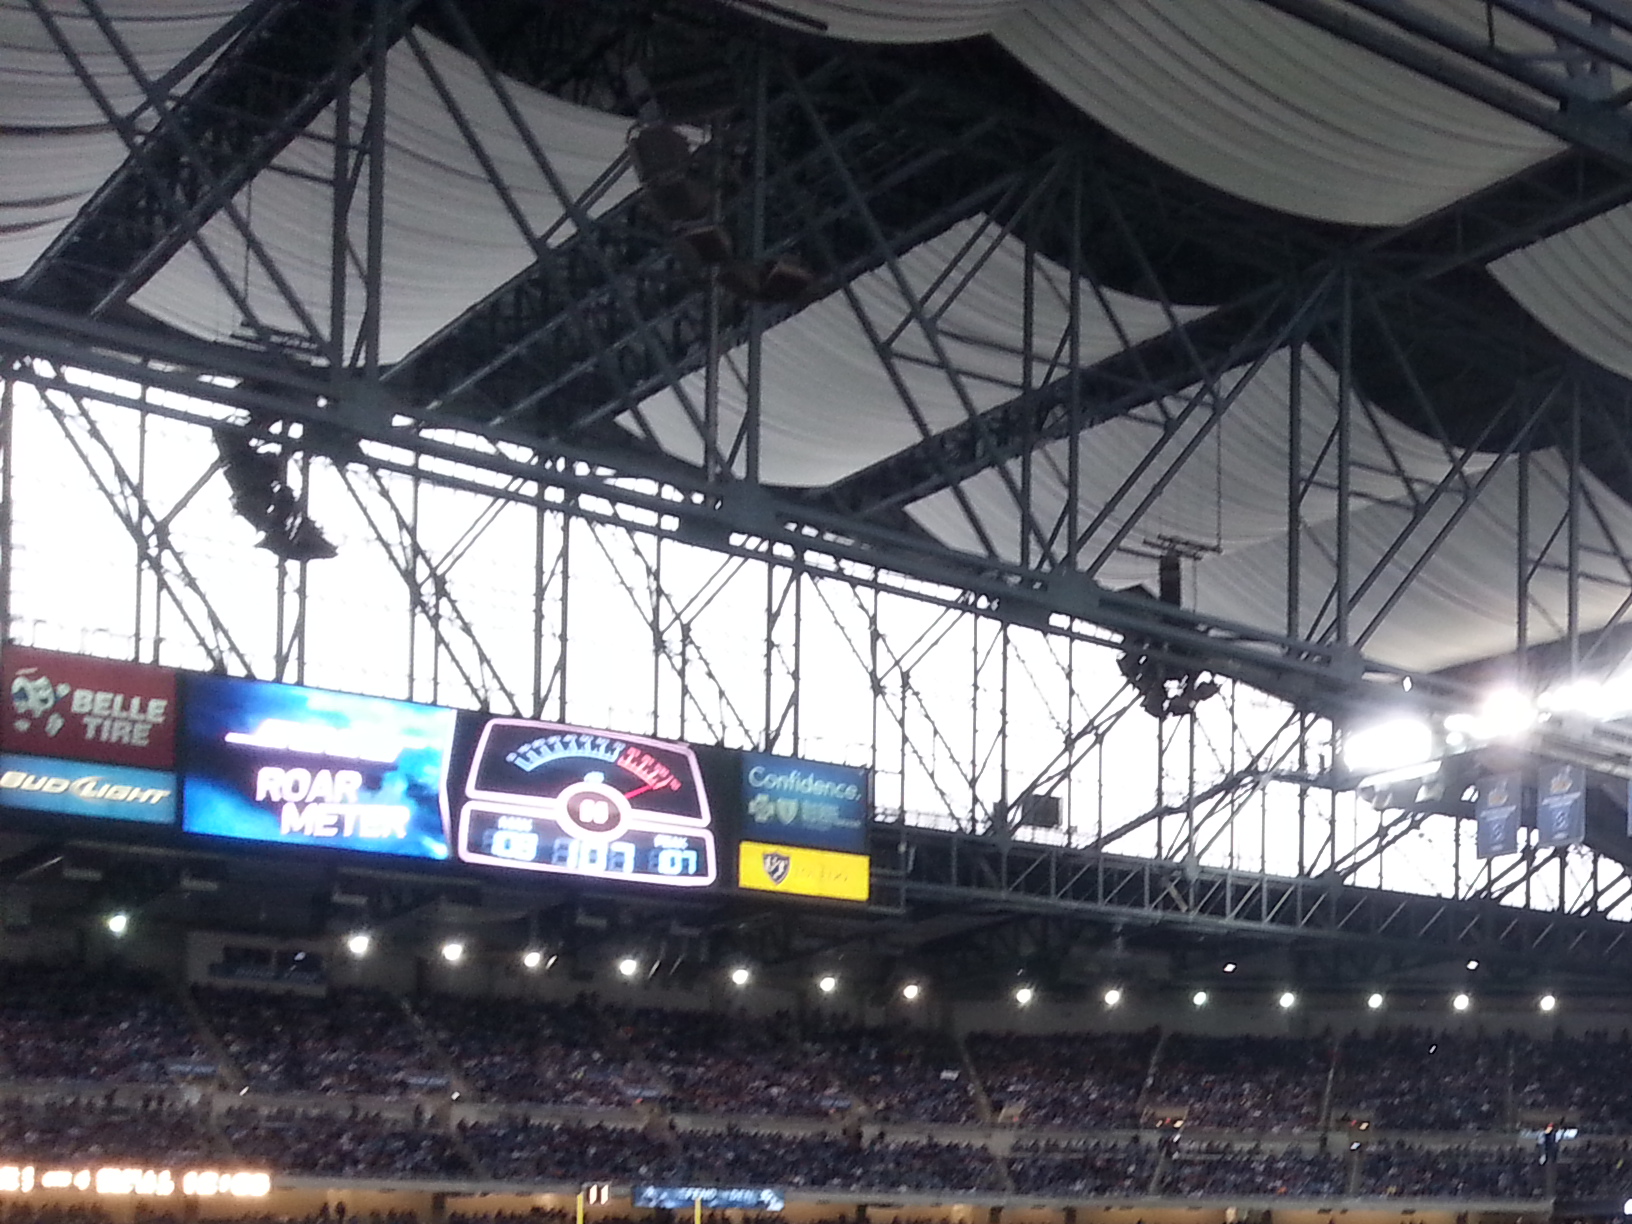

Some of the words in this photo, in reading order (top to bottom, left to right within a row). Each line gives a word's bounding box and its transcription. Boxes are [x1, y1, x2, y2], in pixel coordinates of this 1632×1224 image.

[71, 688, 168, 724] BELLE
[83, 725, 153, 747] TIRE
[81, 780, 171, 804] LIGHT
[255, 766, 363, 805] ROAR
[280, 802, 411, 839] METER
